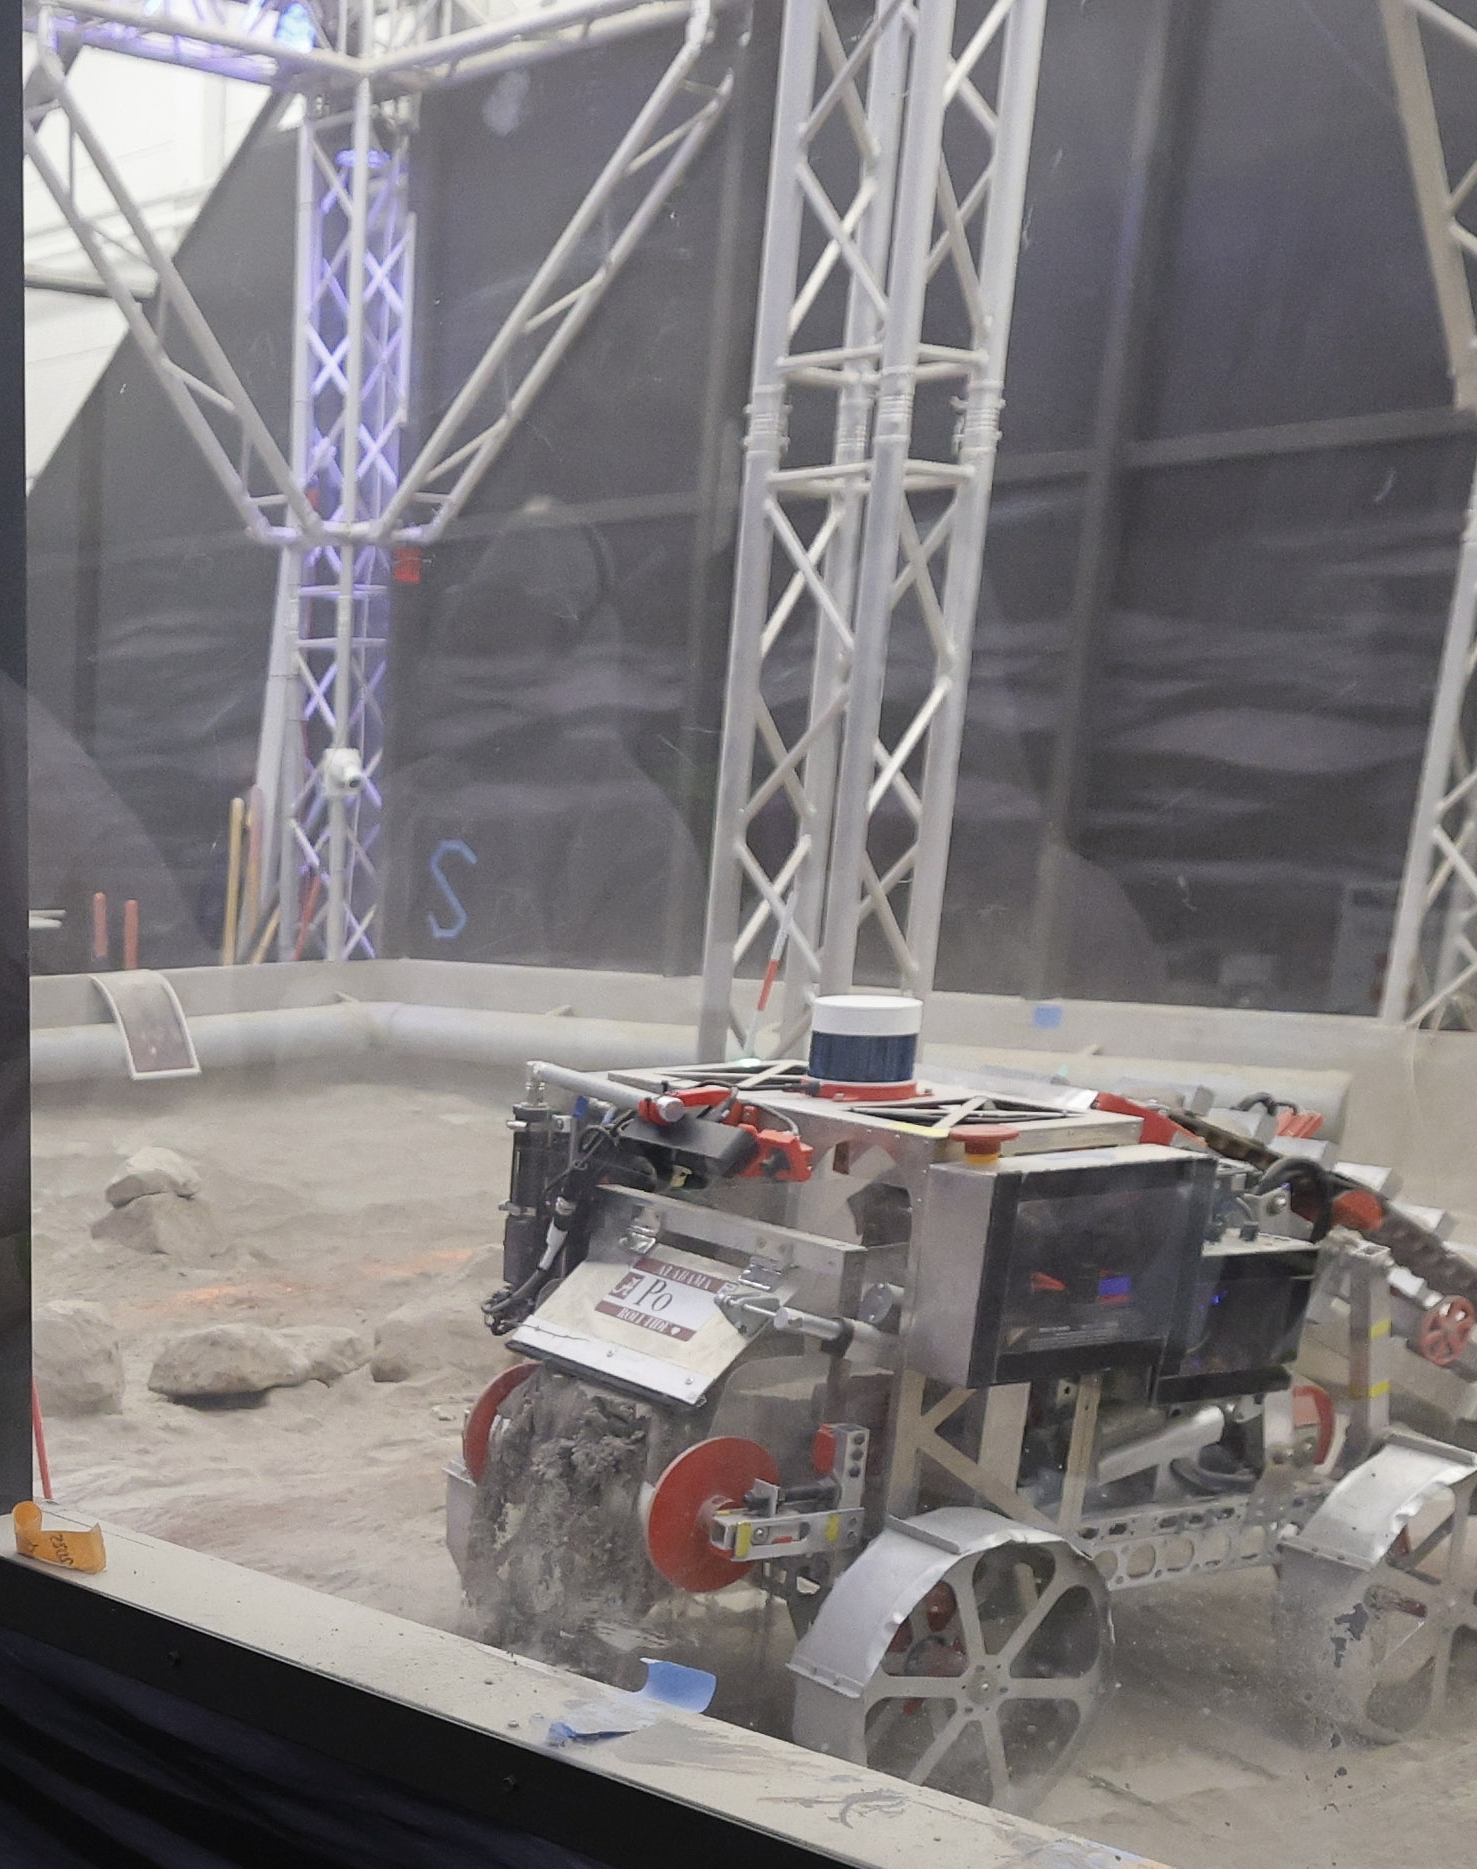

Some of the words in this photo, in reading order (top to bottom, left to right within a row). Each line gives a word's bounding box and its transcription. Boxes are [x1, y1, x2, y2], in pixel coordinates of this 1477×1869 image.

[427, 839, 479, 939] S
[658, 1264, 712, 1289] ALABAMA
[633, 1278, 673, 1311] Po
[617, 1306, 644, 1324] ROLL
[645, 1314, 670, 1332] TIDE
